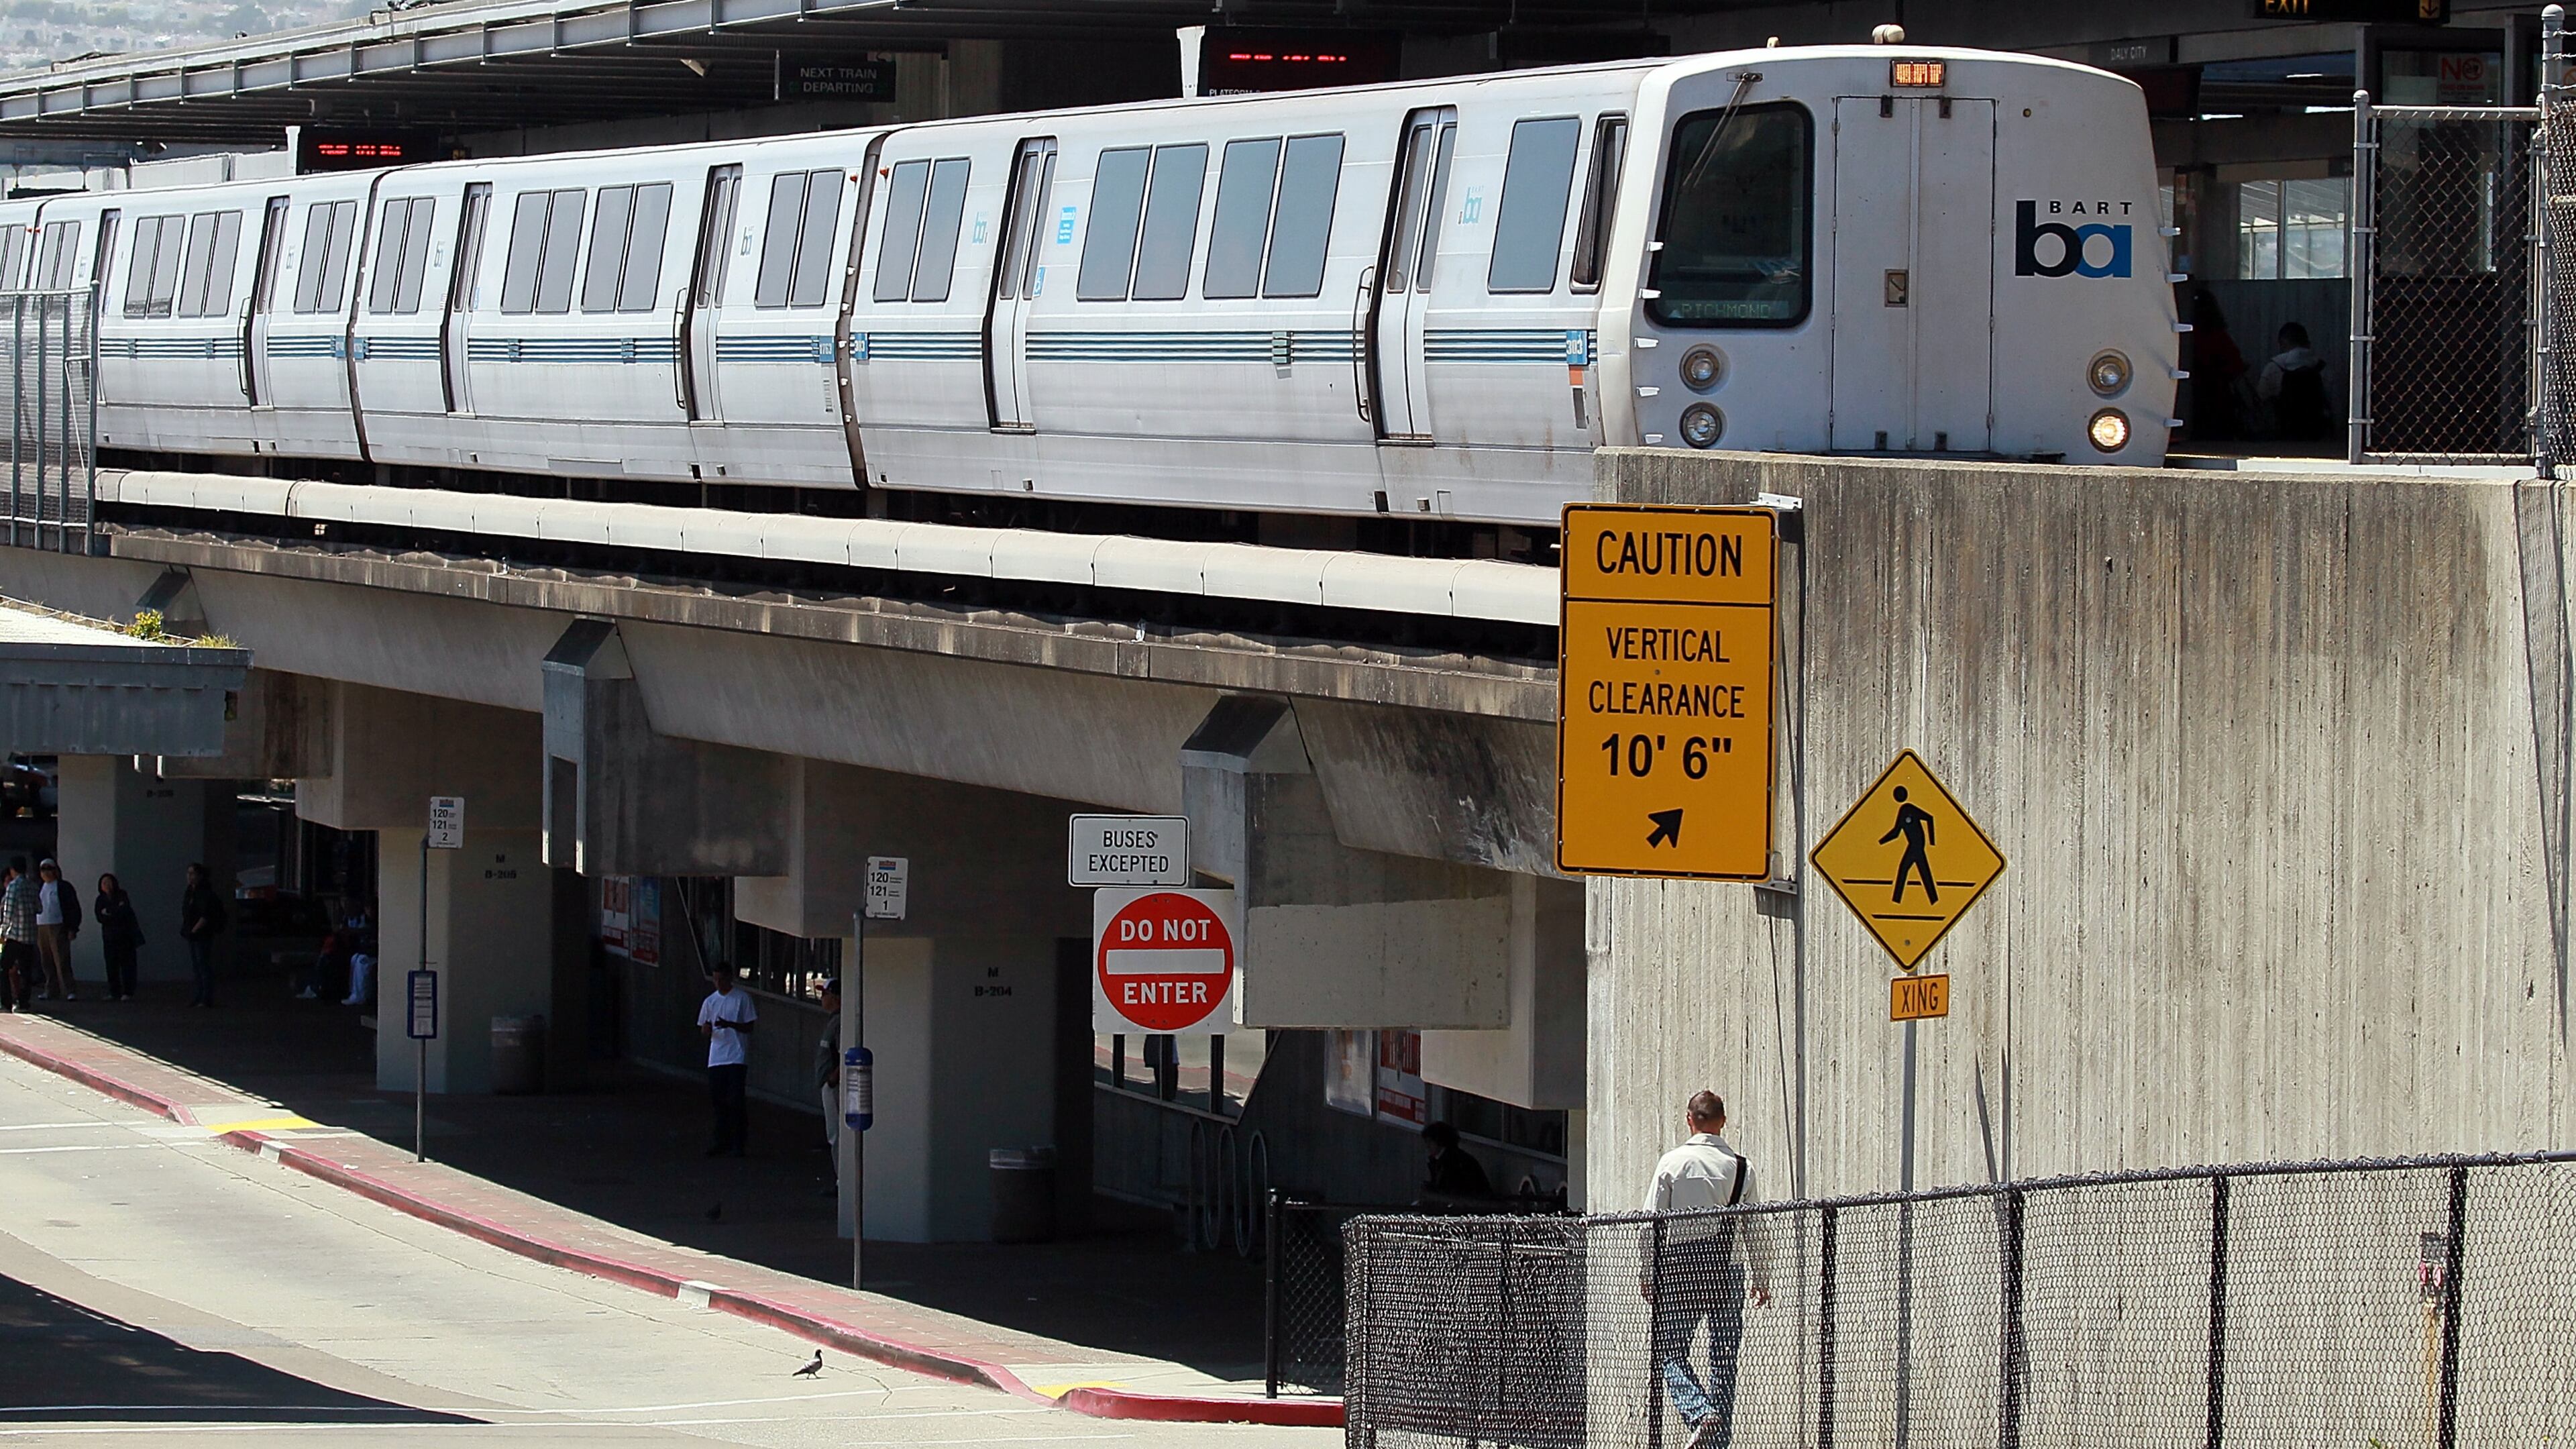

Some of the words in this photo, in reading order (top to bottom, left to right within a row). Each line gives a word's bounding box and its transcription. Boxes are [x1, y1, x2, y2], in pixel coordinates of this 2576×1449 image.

[2111, 47, 2129, 60] DALY
[2131, 46, 2147, 59] CITY
[800, 68, 835, 78] NEXT
[839, 68, 877, 79] TRAIN
[803, 81, 874, 93] DEPARTING
[2049, 201, 2132, 215] BART
[1681, 303, 1771, 319] RICHMOND
[1566, 339, 1583, 355] 303
[1597, 529, 1742, 578] CAUTION
[1606, 627, 1731, 663] VERTICAL
[1589, 680, 1745, 718] CLEARANCE
[1601, 733, 1666, 778] 10'
[1682, 735, 1732, 780] 6"
[433, 808, 448, 818] 120
[433, 820, 447, 829] 121
[442, 832, 448, 841] 2
[1103, 830, 1156, 849] BUSES
[1089, 854, 1169, 873] EXCEPTED
[870, 872, 889, 883] 120
[870, 885, 887, 896] 121
[883, 900, 888, 910] 1
[1120, 919, 1154, 942] DO
[1163, 918, 1211, 941] NOT
[974, 985, 1012, 997] B-204
[1124, 981, 1208, 1004] ENTER
[1901, 981, 1939, 1014] XING
